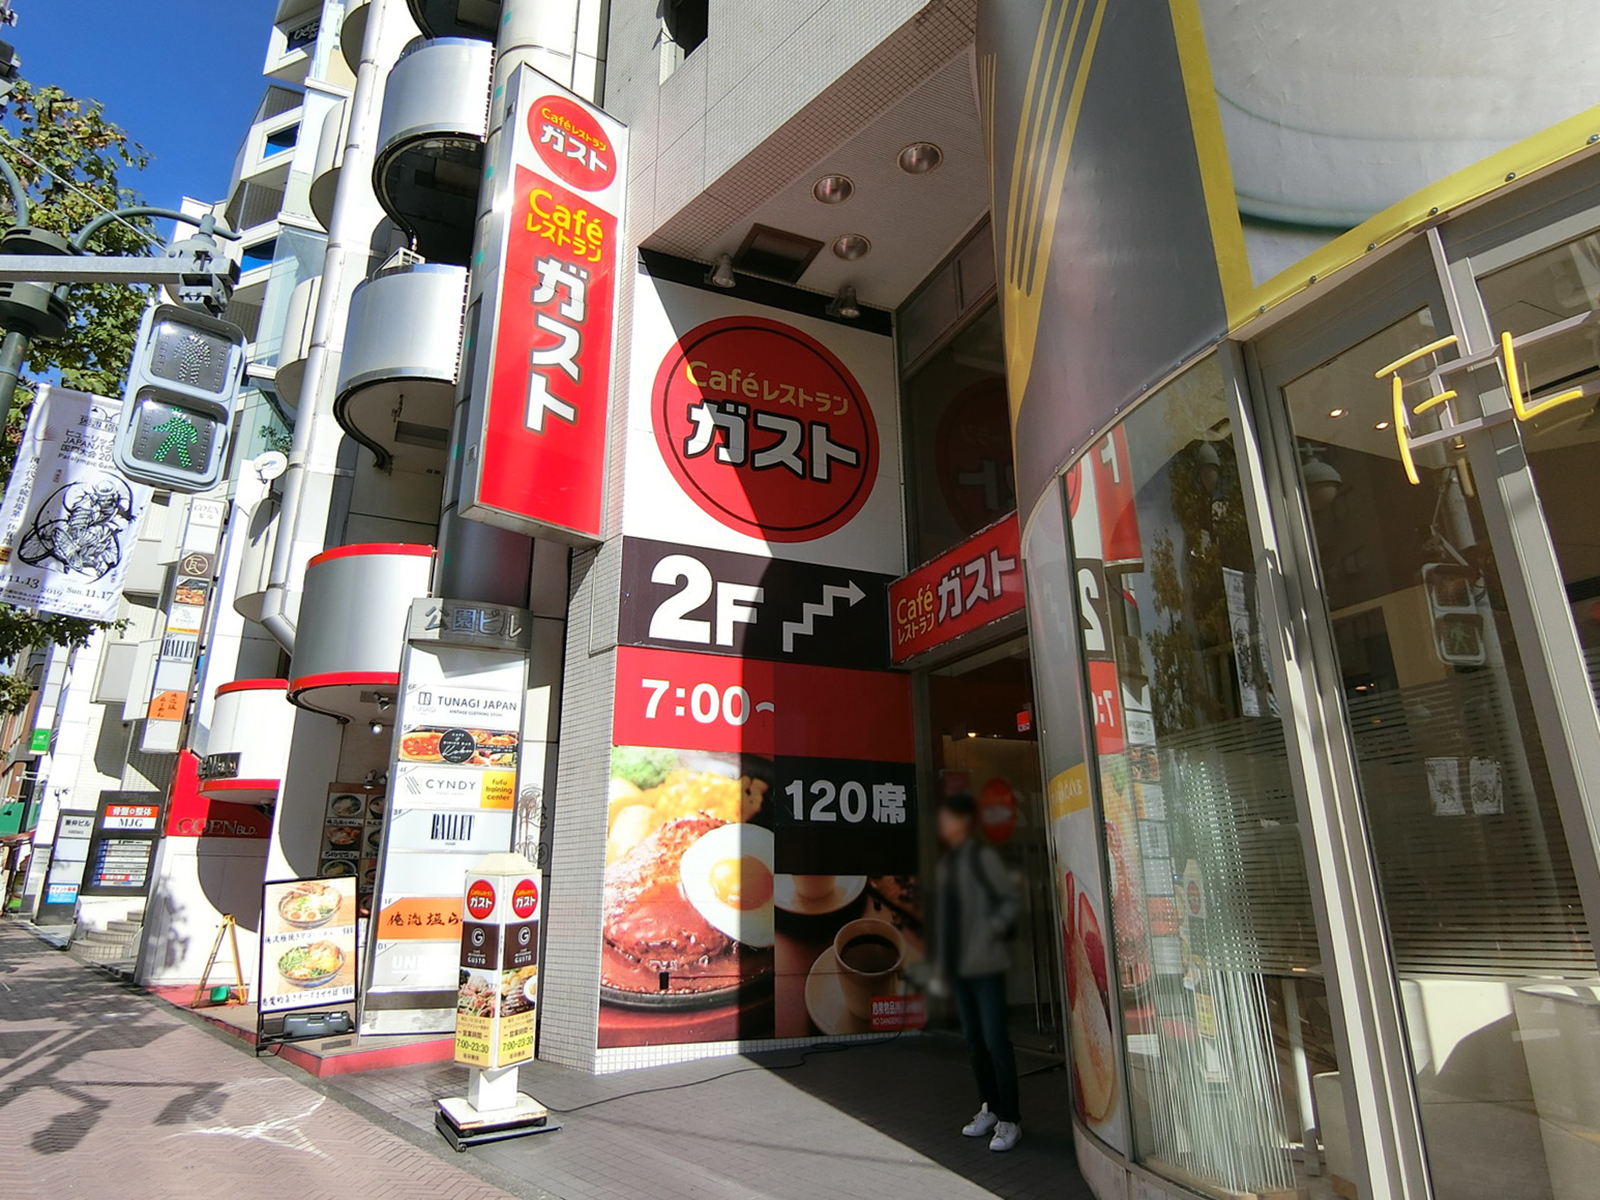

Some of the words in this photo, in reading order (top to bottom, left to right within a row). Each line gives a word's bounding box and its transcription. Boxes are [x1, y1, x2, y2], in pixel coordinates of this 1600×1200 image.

[539, 123, 608, 172] ガスト
[529, 188, 603, 245] Café
[526, 213, 602, 262] レストラン
[525, 256, 589, 434] ガスト
[685, 400, 859, 482] ガスト
[58, 453, 97, 467] Paralympic
[8, 575, 40, 589] 11.13
[938, 549, 1015, 624] ガスト
[41, 588, 63, 597] 2019
[85, 589, 114, 601] 11.17
[648, 554, 764, 647] 2F
[896, 584, 933, 625] Café
[425, 606, 523, 638] 公園ビル
[897, 612, 935, 645] レストラン
[437, 696, 480, 708] TUNAGI
[482, 700, 517, 711] JAPAN
[425, 778, 477, 791] CYNDY
[485, 786, 512, 795] training
[486, 793, 510, 801] center
[785, 779, 907, 824] 120席
[118, 818, 143, 828] MJG
[177, 818, 238, 835] COEN
[431, 813, 475, 841] BALLET
[470, 896, 492, 909] ガスト
[515, 896, 536, 909] ガスト
[387, 911, 463, 928] 俺流塩ら
[467, 956, 486, 965] GUSTO
[514, 955, 532, 964] GUSTO
